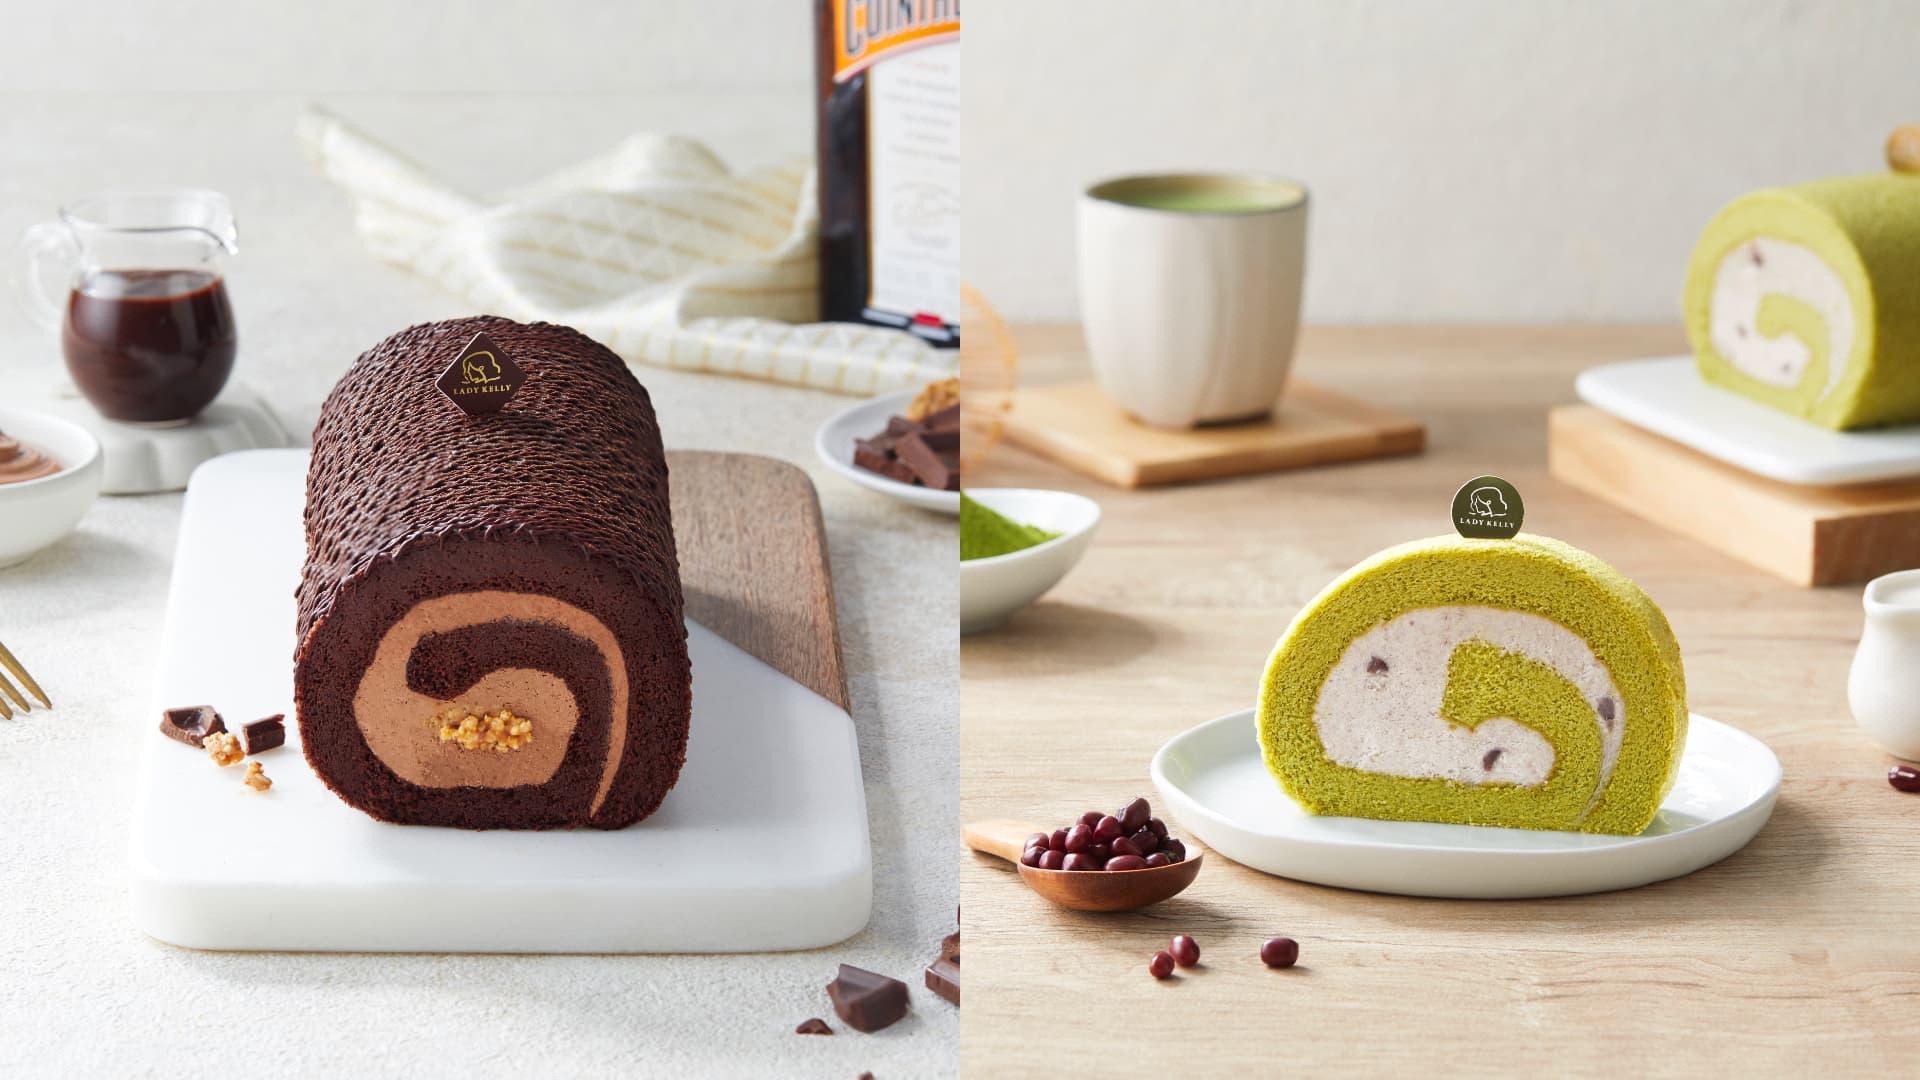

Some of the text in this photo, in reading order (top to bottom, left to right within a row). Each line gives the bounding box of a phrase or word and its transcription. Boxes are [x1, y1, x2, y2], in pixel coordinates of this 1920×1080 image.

[453, 384, 512, 395] LADY KELLY
[1460, 517, 1515, 529] LADY KELLY
